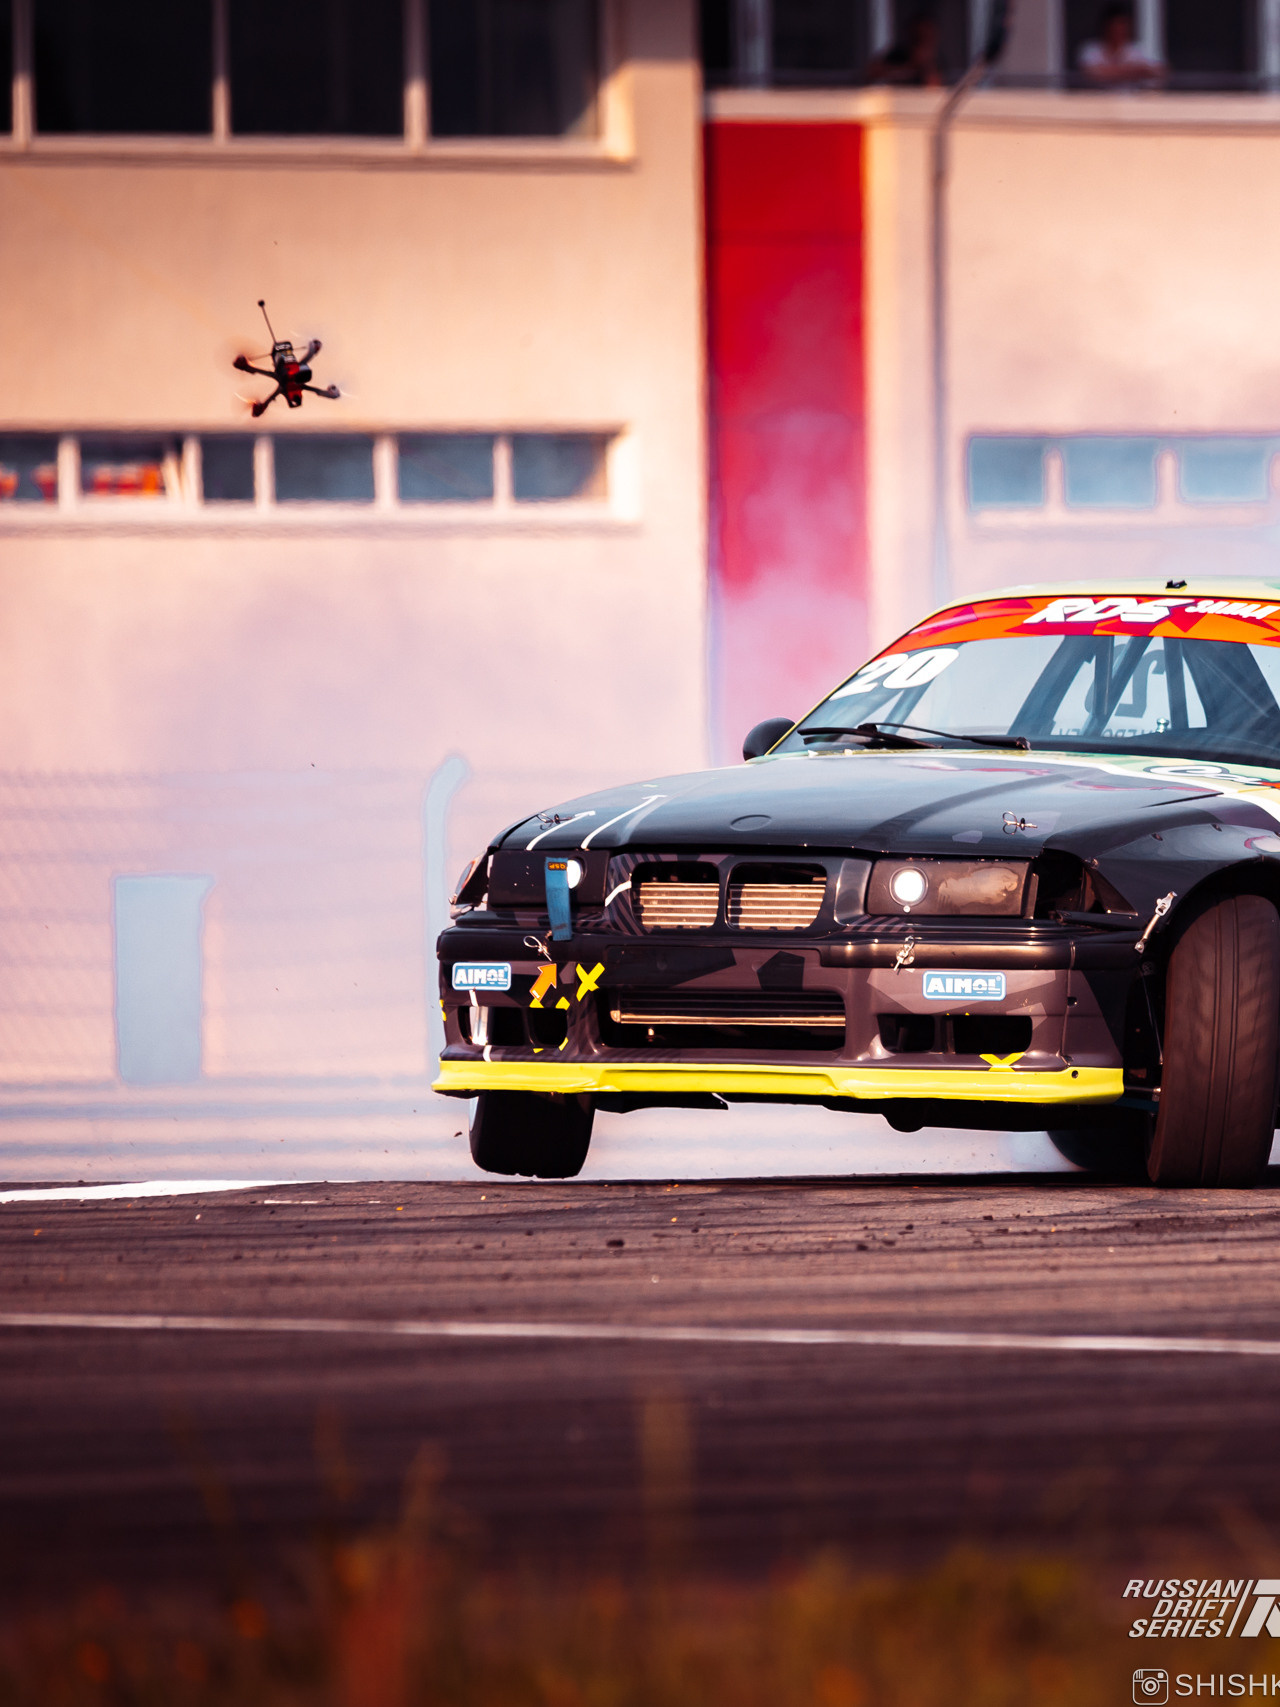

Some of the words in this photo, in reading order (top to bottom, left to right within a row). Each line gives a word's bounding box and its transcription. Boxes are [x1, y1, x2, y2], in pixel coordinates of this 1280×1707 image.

[1023, 597, 1195, 624] RDS
[829, 648, 960, 701] 20
[454, 968, 508, 985] AIMOL
[926, 977, 1001, 994] AIMOL
